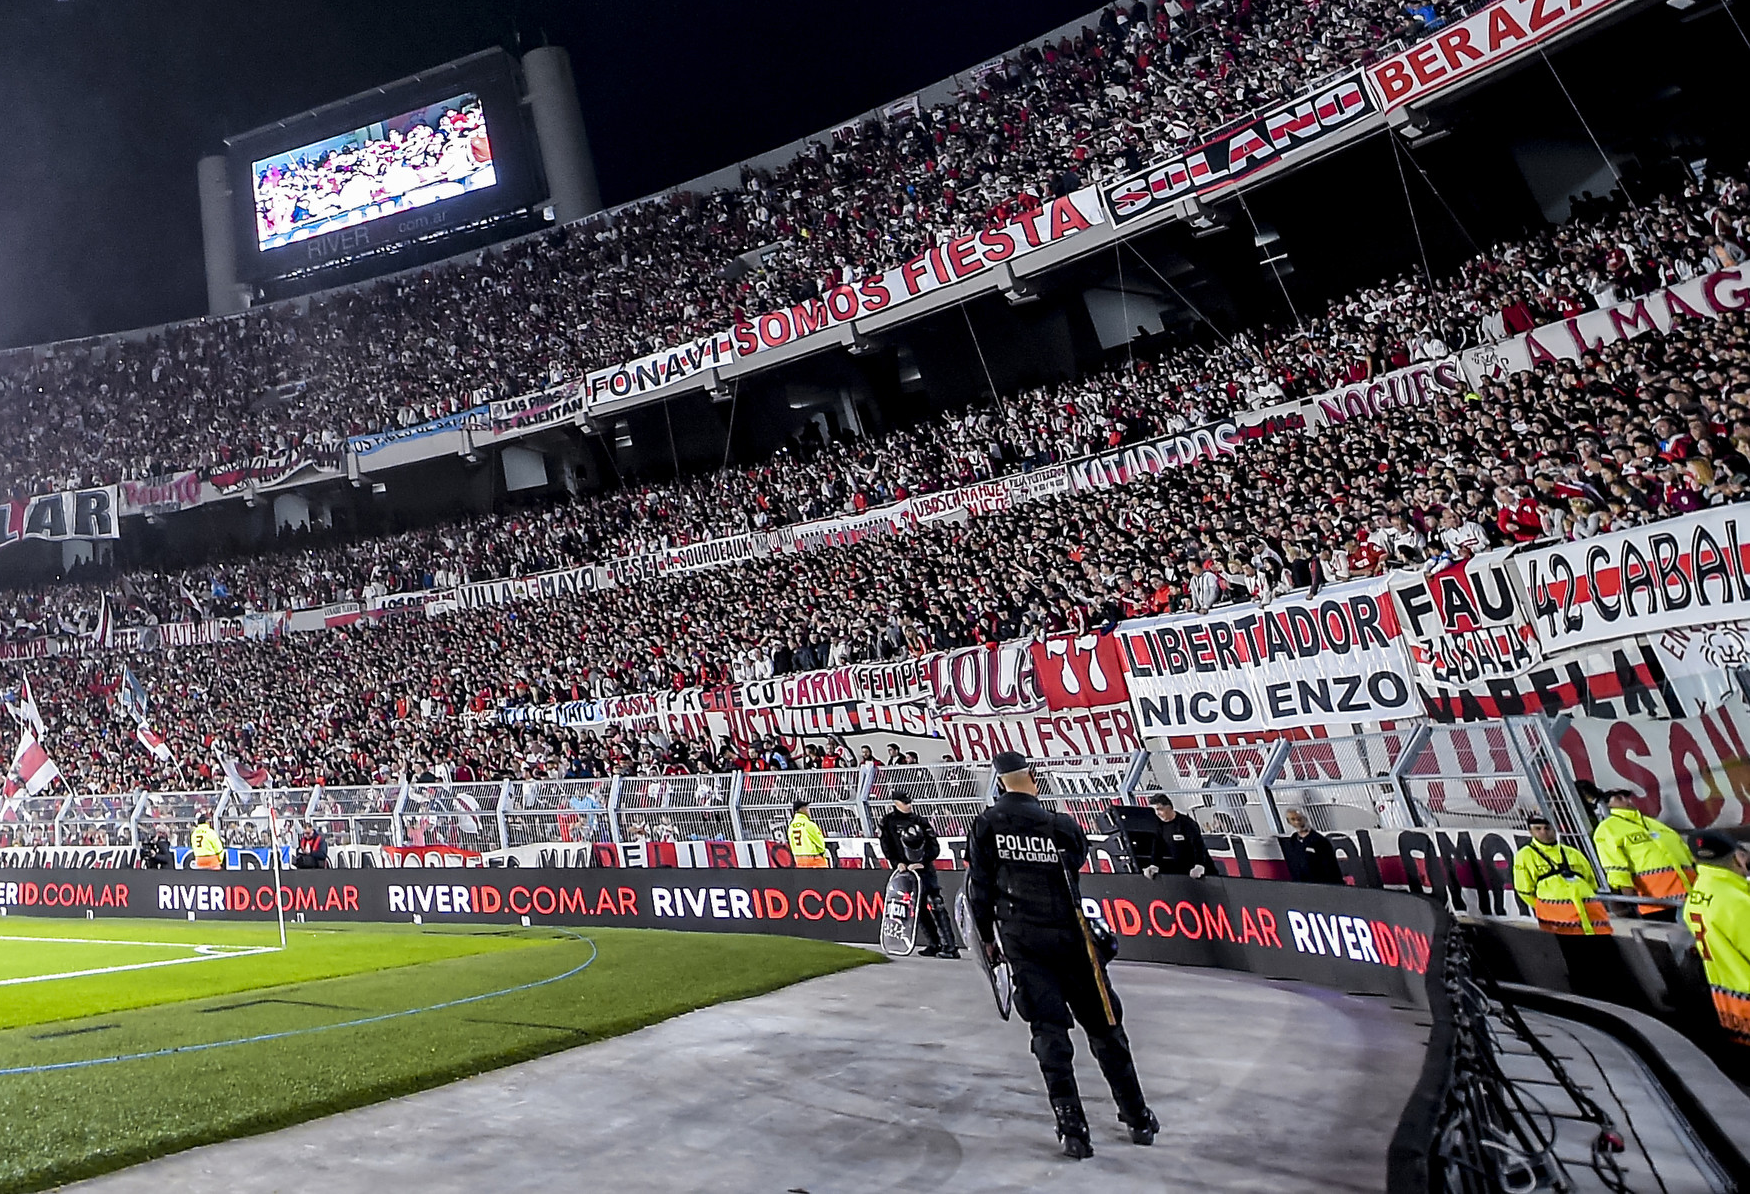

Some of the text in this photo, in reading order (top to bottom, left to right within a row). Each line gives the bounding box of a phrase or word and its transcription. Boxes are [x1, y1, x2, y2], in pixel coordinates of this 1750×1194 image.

[1110, 81, 1366, 216] SOLANO
[307, 226, 371, 259] RIVER
[734, 194, 1093, 356] SOMOS FIESTA
[590, 336, 722, 405] FONAVI
[505, 395, 527, 415] LAS
[1320, 362, 1462, 427] NOGUES
[517, 398, 583, 430] ALIENTAN
[961, 481, 1009, 504] NAHUEL
[679, 536, 751, 567] SOURDEAUX
[461, 583, 514, 609] VILLA
[539, 567, 596, 599] MAYO
[1396, 565, 1514, 637] FAU
[1529, 552, 1584, 638] 42
[160, 620, 217, 645] MATHEU
[1120, 594, 1390, 678] LIBERTADOR
[17, 639, 48, 660] RIVER
[1427, 626, 1533, 683] ZABALA
[782, 666, 852, 707] GARIN
[858, 660, 932, 701] FELIPE
[1417, 649, 1659, 724] VARELA
[1139, 670, 1409, 728] NICO ENZO
[772, 703, 943, 737] VILLA ELISA
[195, 835, 204, 849] 3
[593, 841, 795, 868] DELIRIO
[793, 829, 803, 848] 3
[995, 834, 1057, 853] POLICIA
[999, 849, 1059, 864] DE LA CIUDAD
[157, 884, 360, 913] RIVERID.COM.AR
[387, 885, 639, 917] RIVERID.COM.AR
